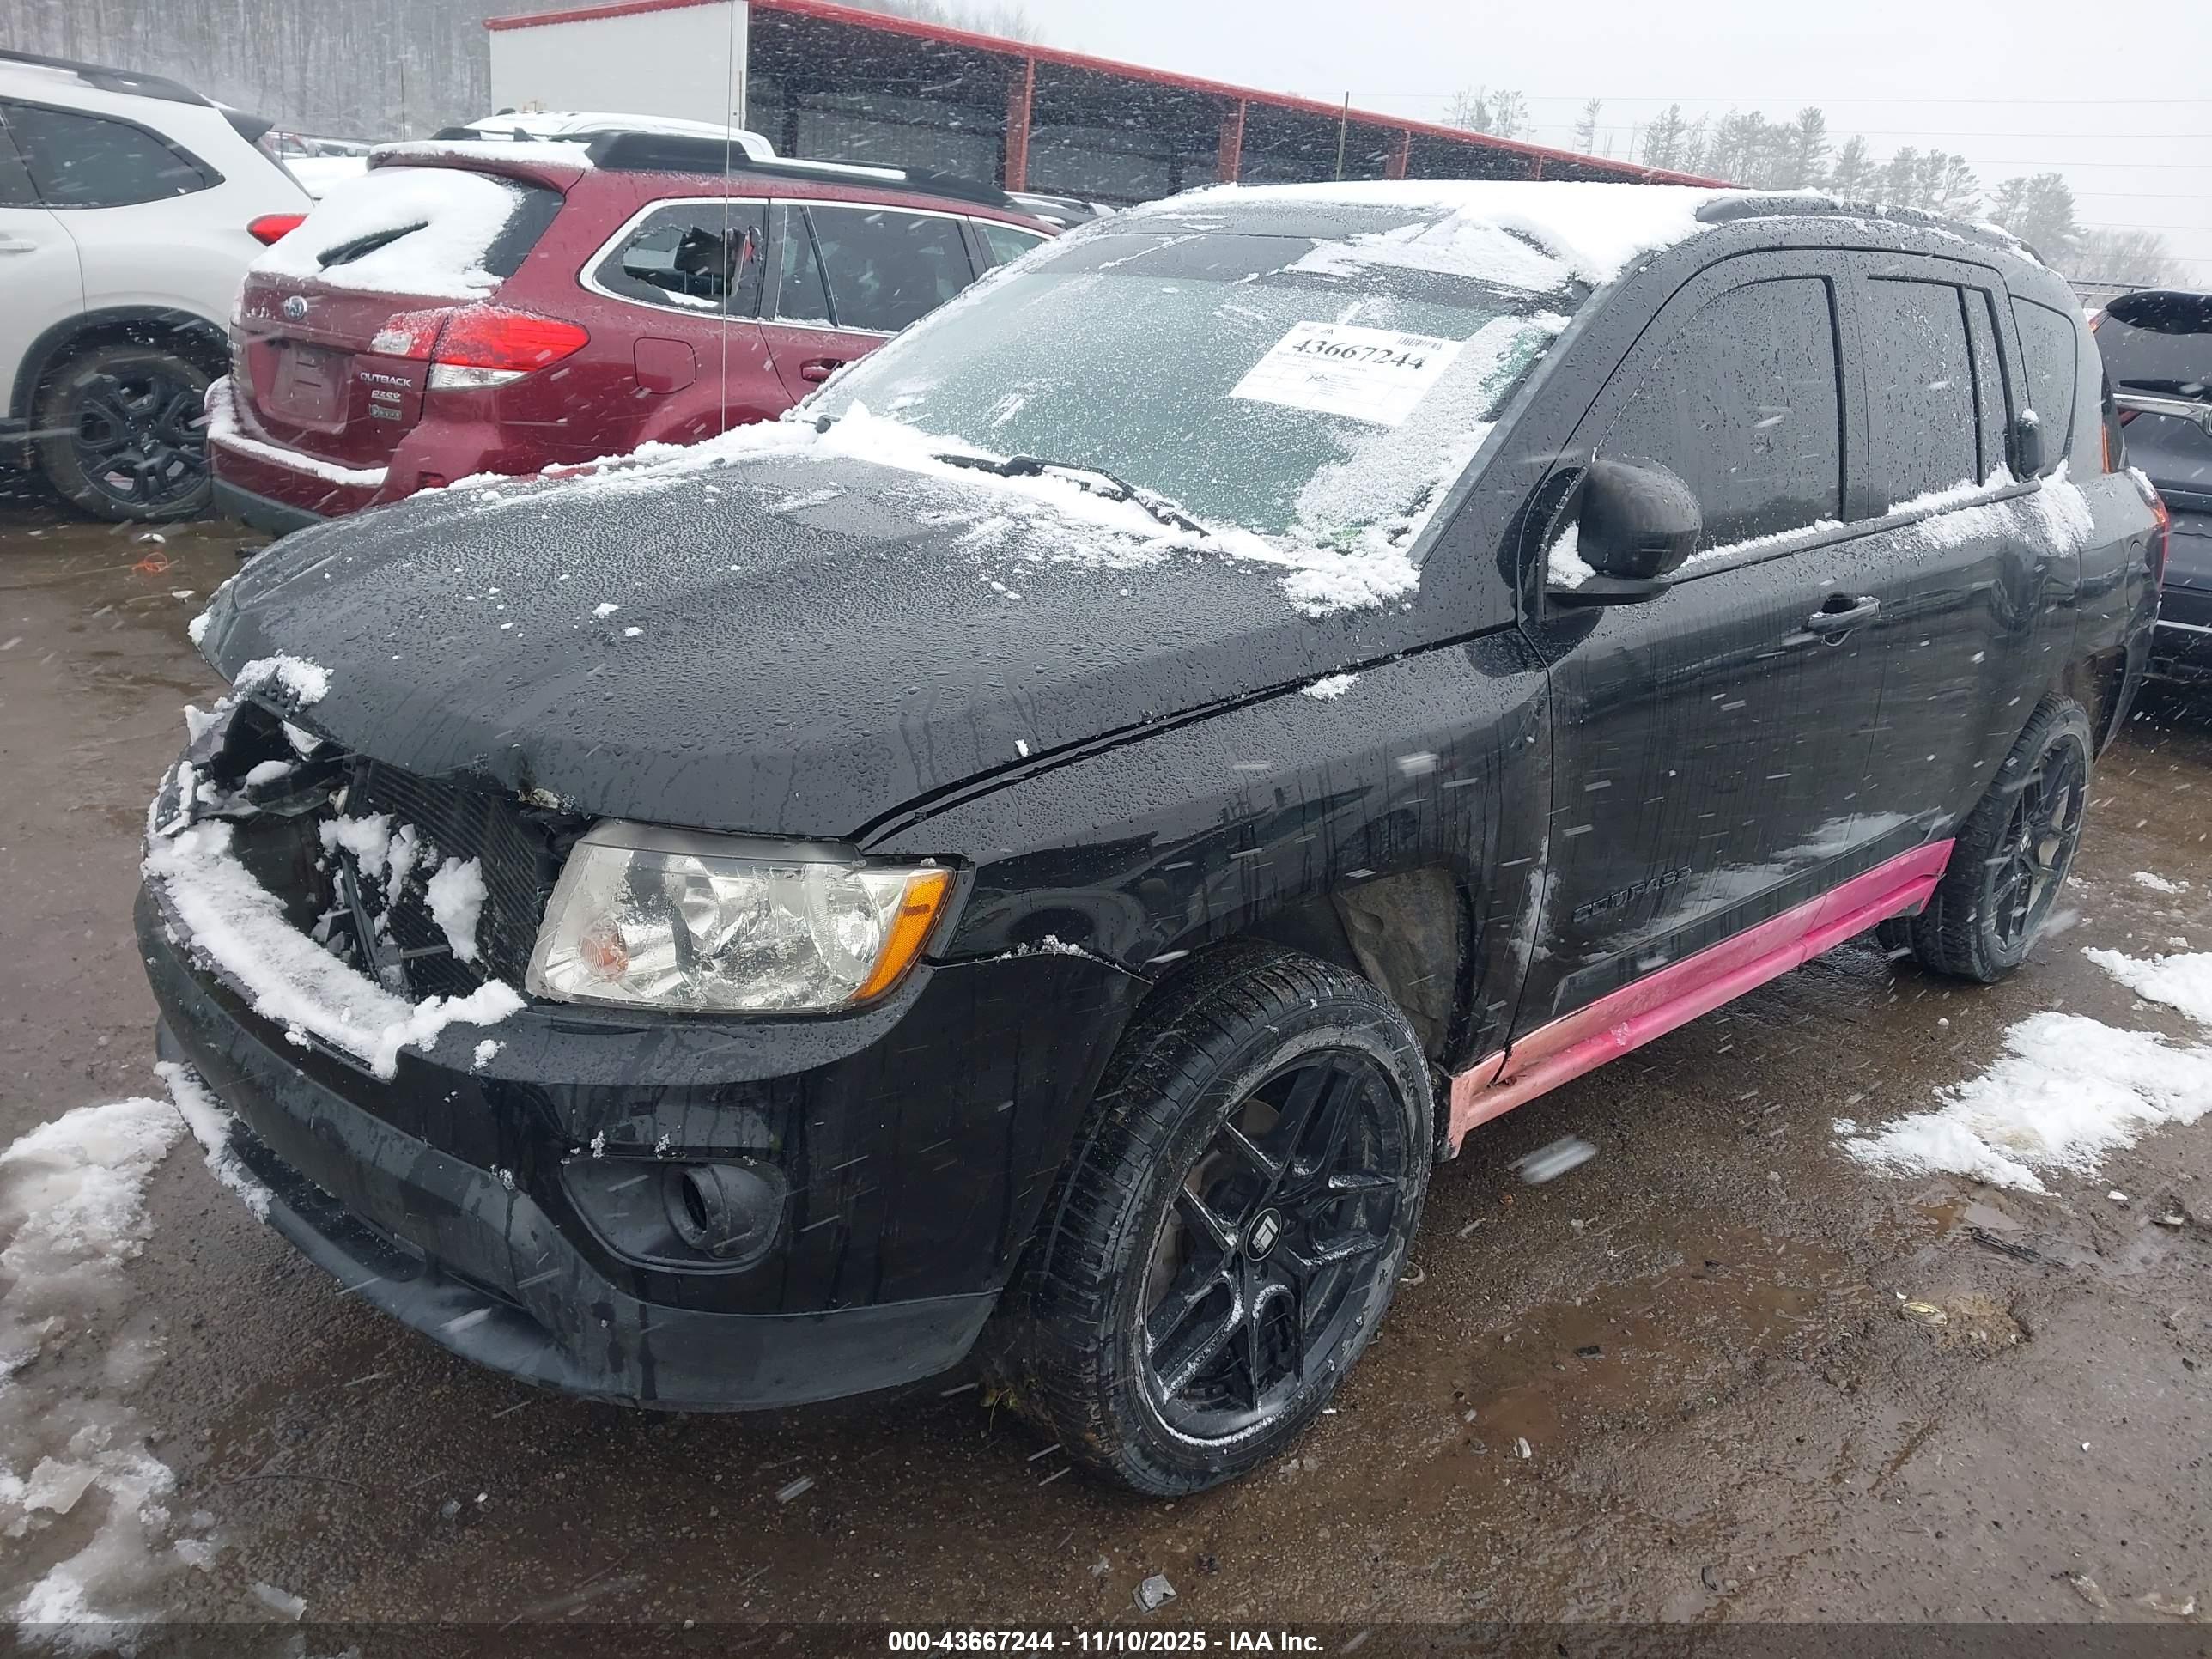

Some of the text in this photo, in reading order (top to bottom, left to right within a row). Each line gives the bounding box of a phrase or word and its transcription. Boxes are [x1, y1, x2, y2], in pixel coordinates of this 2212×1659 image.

[1292, 338, 1426, 370] 43667244
[360, 372, 413, 388] OUTBACK
[1572, 865, 1693, 923] COMPASS
